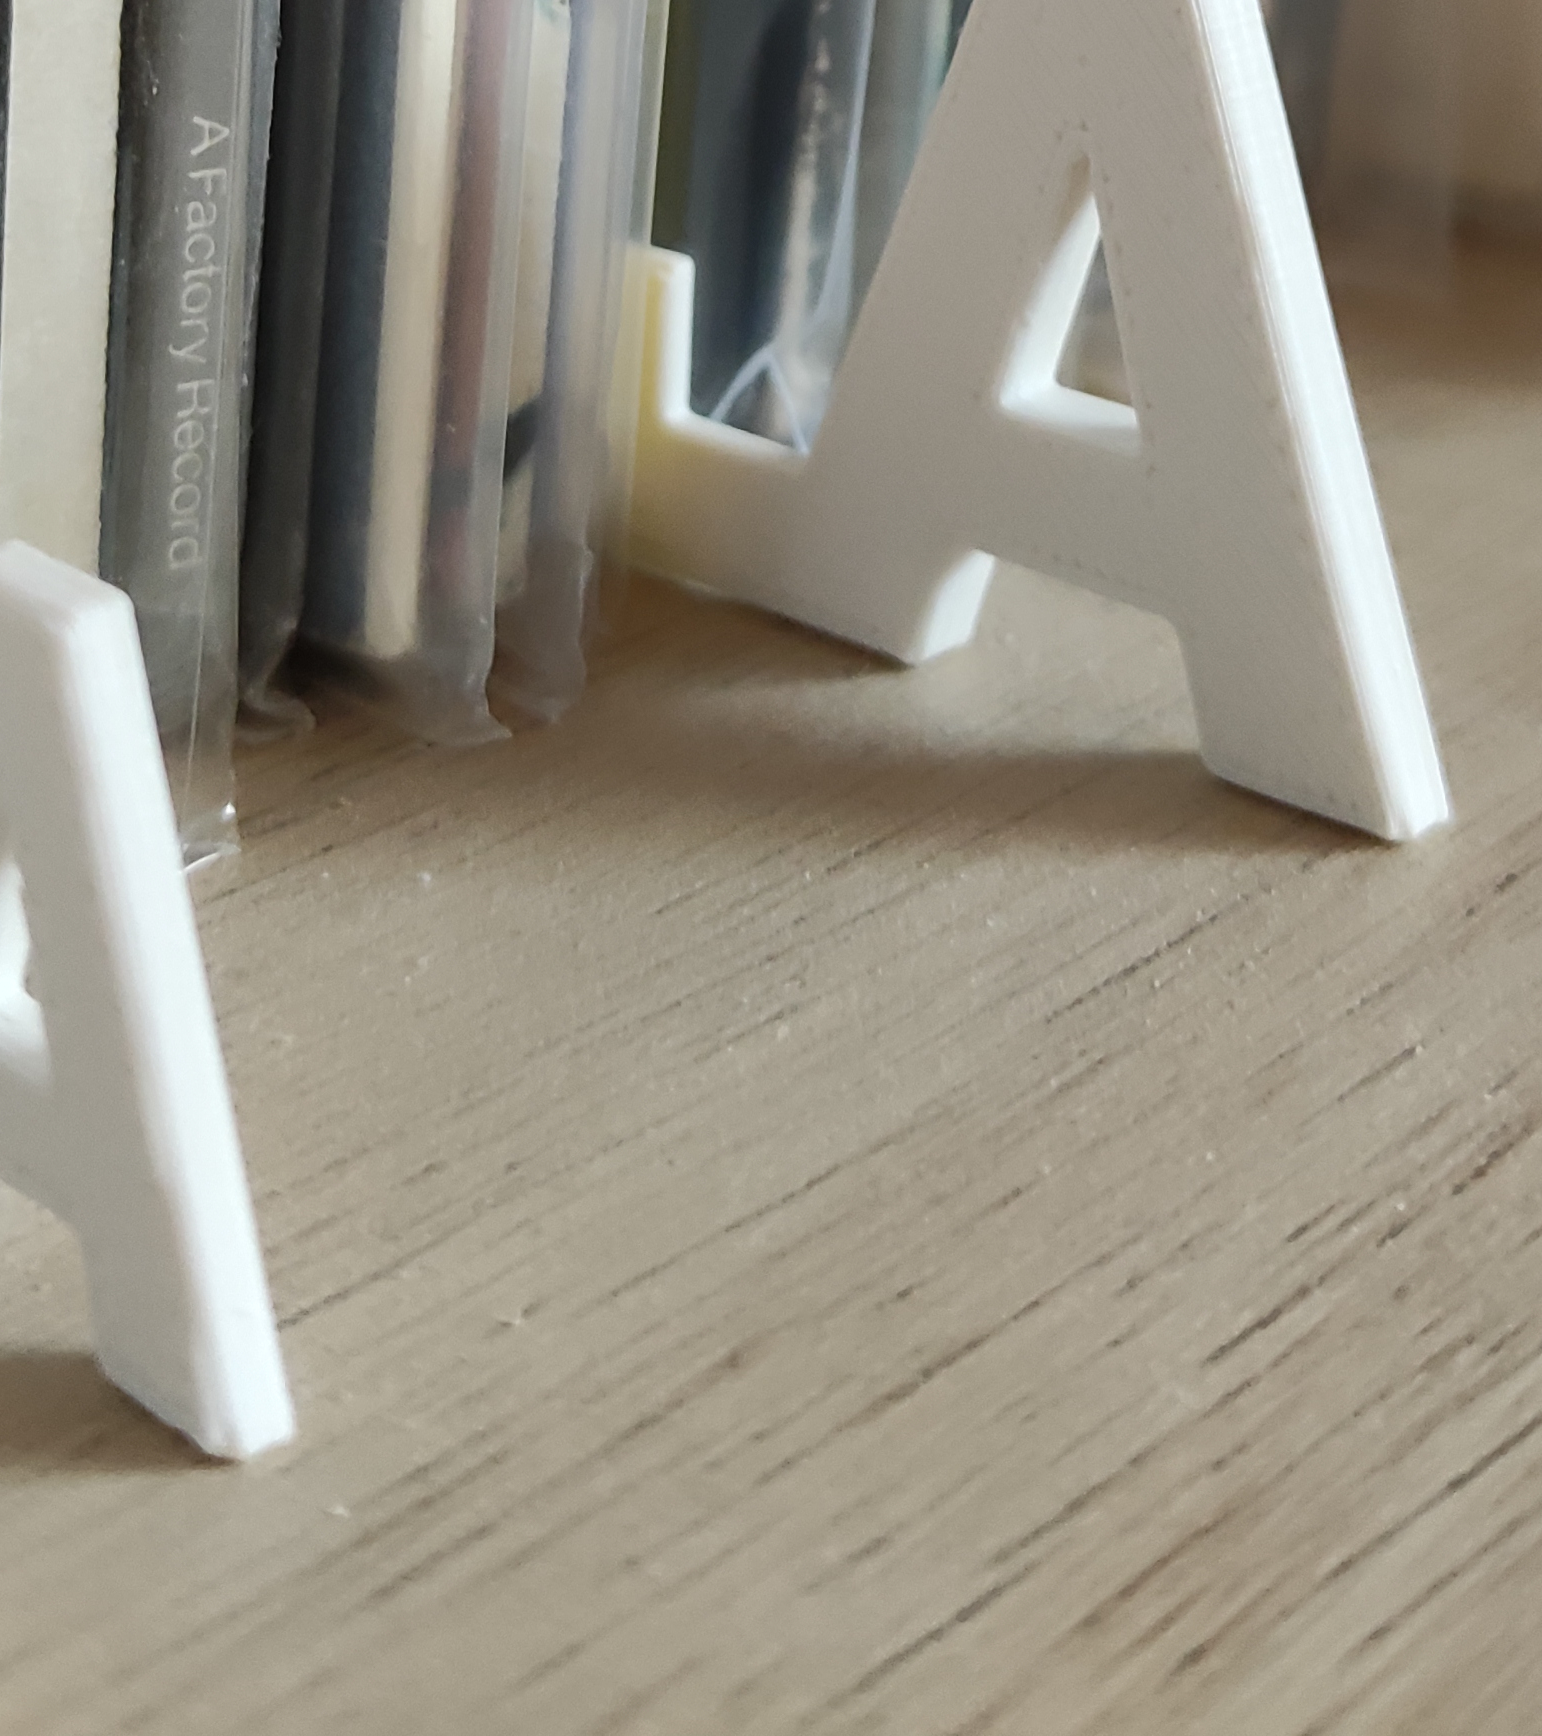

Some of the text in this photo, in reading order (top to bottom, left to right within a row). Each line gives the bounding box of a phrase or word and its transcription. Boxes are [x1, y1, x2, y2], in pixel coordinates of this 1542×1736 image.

[167, 114, 230, 574] A Factory Record
